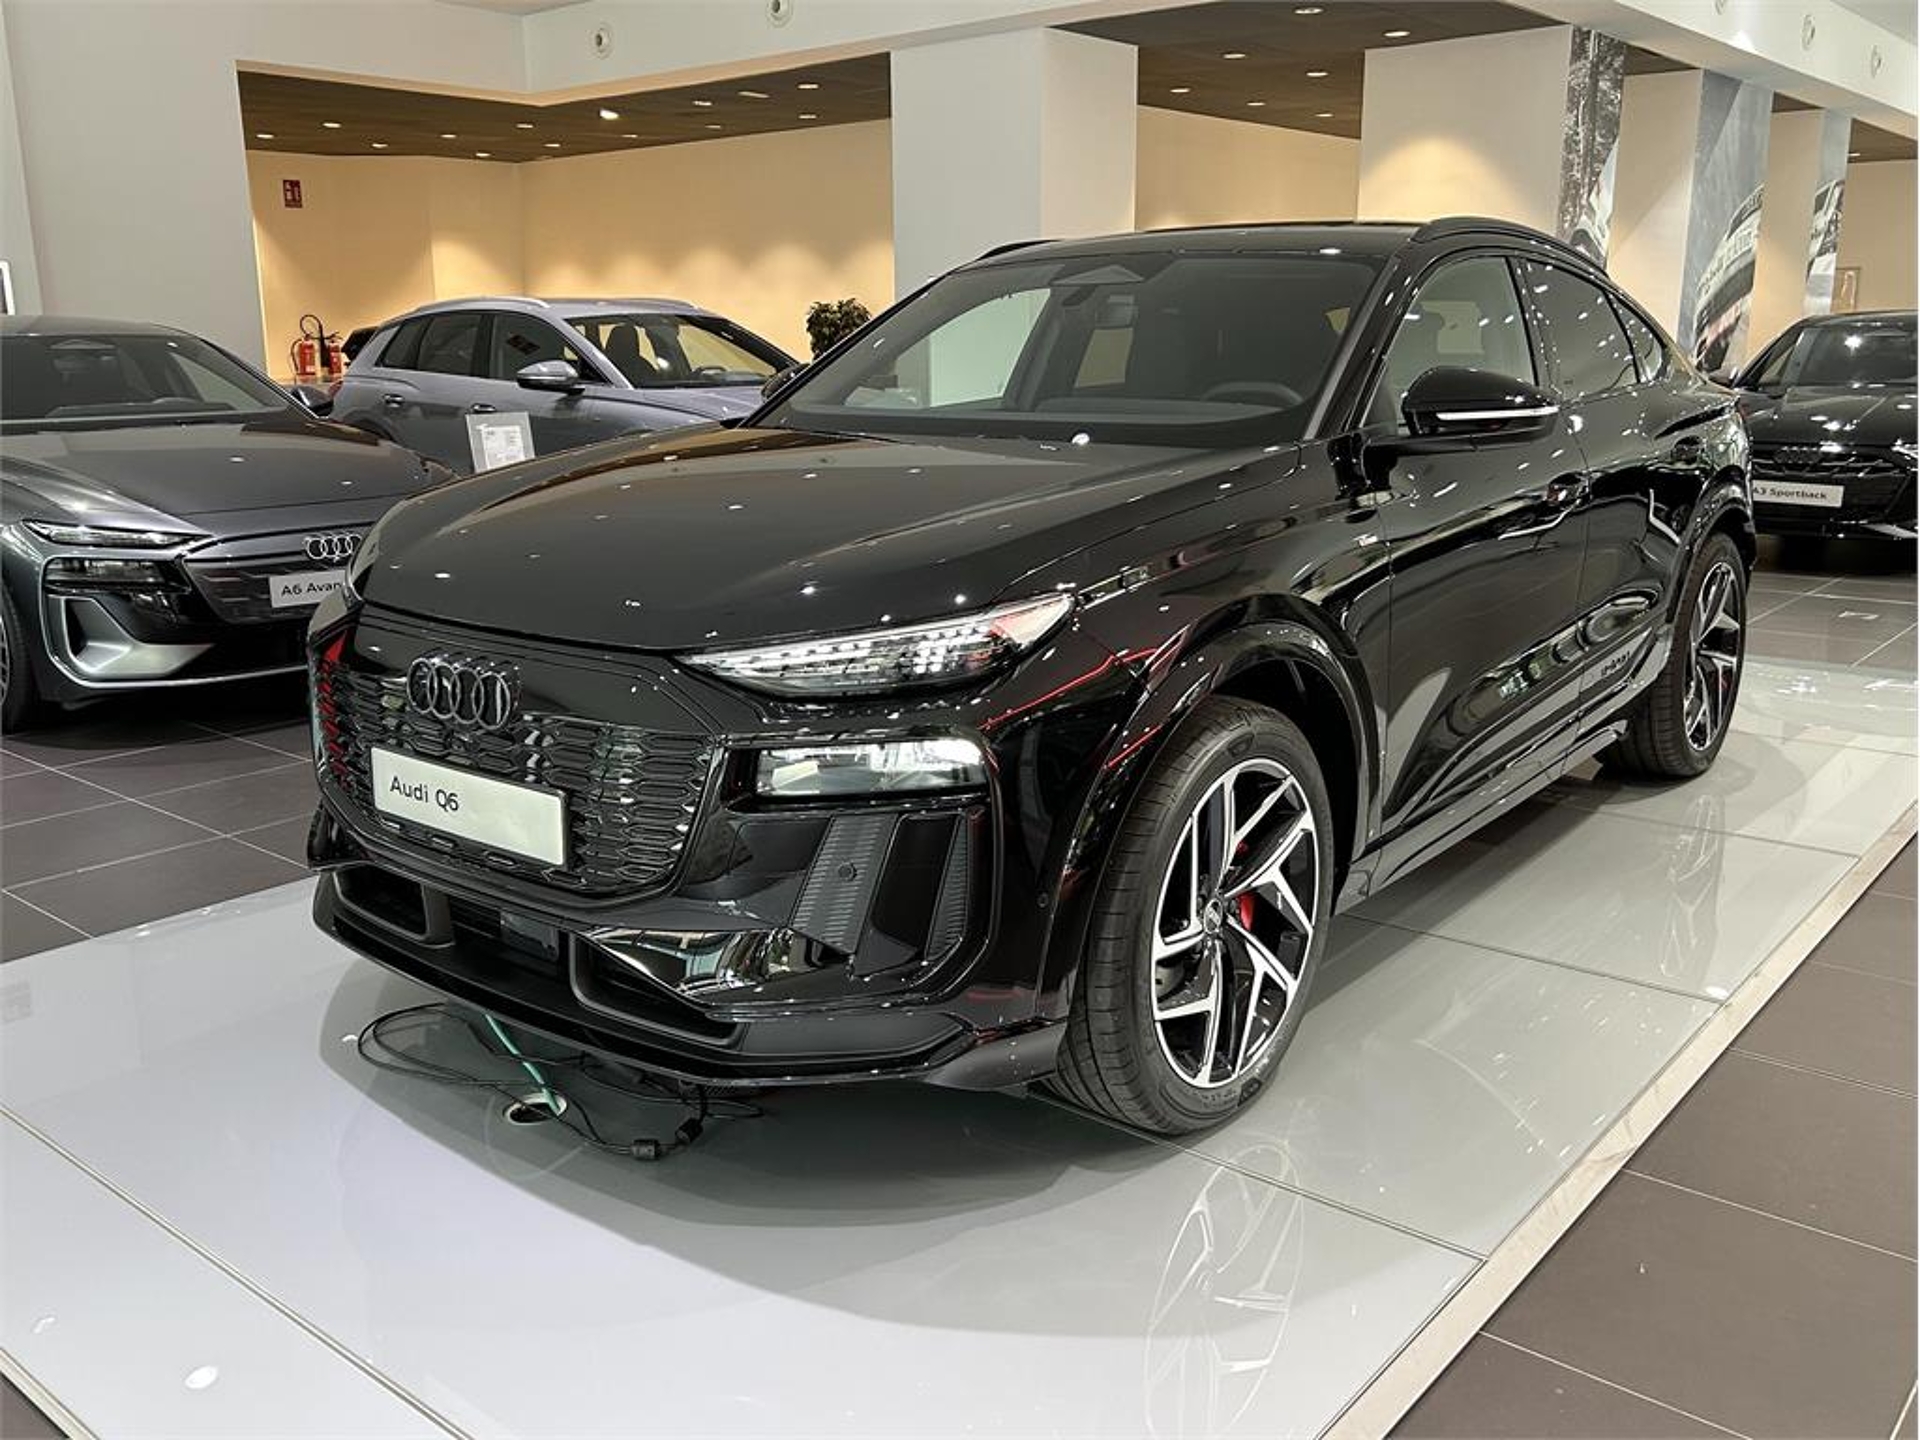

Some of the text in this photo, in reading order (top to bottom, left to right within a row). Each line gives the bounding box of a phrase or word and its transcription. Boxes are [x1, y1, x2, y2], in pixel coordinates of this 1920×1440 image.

[1769, 487, 1827, 500] Sportback
[281, 582, 342, 597] A6 Avan
[389, 775, 460, 812] Audi Q6
